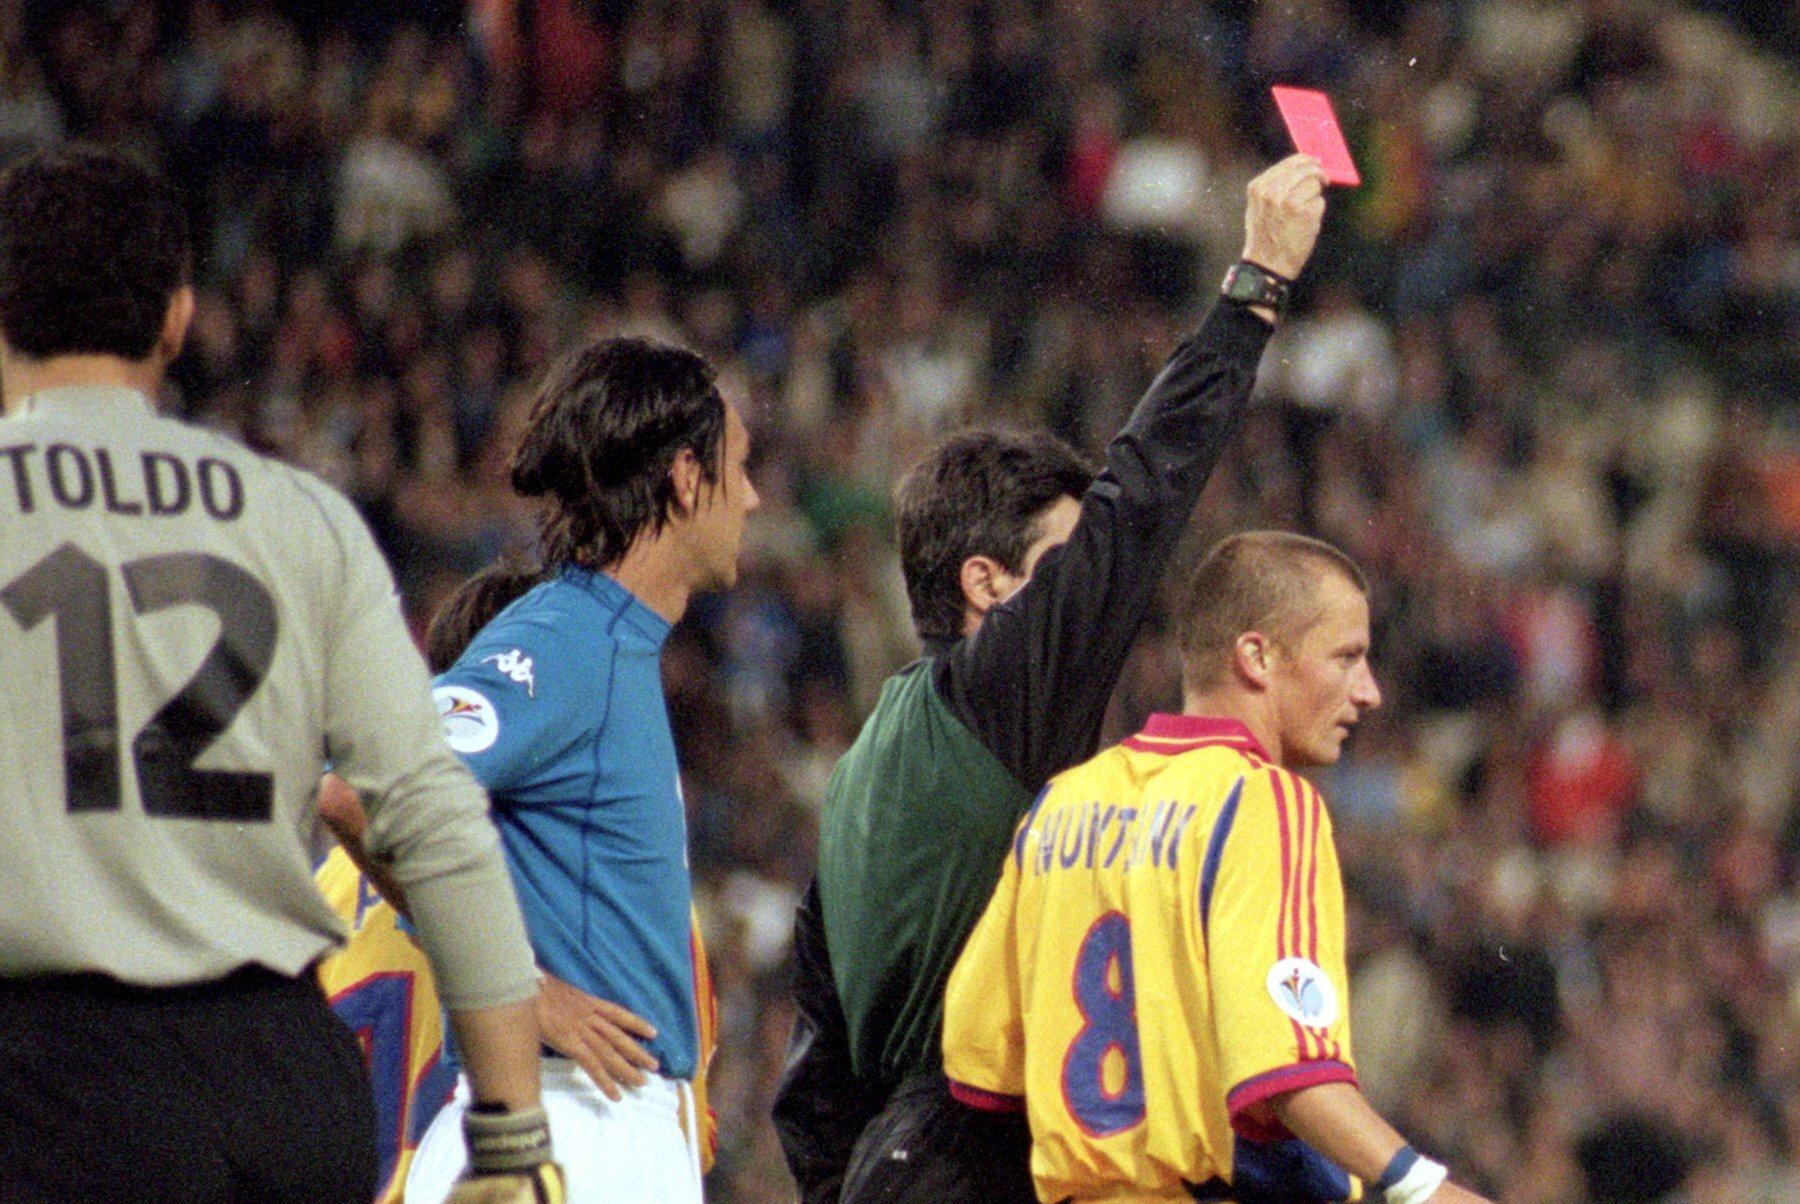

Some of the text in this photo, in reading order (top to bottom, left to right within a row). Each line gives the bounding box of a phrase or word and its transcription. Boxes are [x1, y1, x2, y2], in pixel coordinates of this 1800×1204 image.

[0, 442, 246, 522] TOLDO
[0, 541, 279, 823] 12
[1060, 908, 1147, 1140] 8
